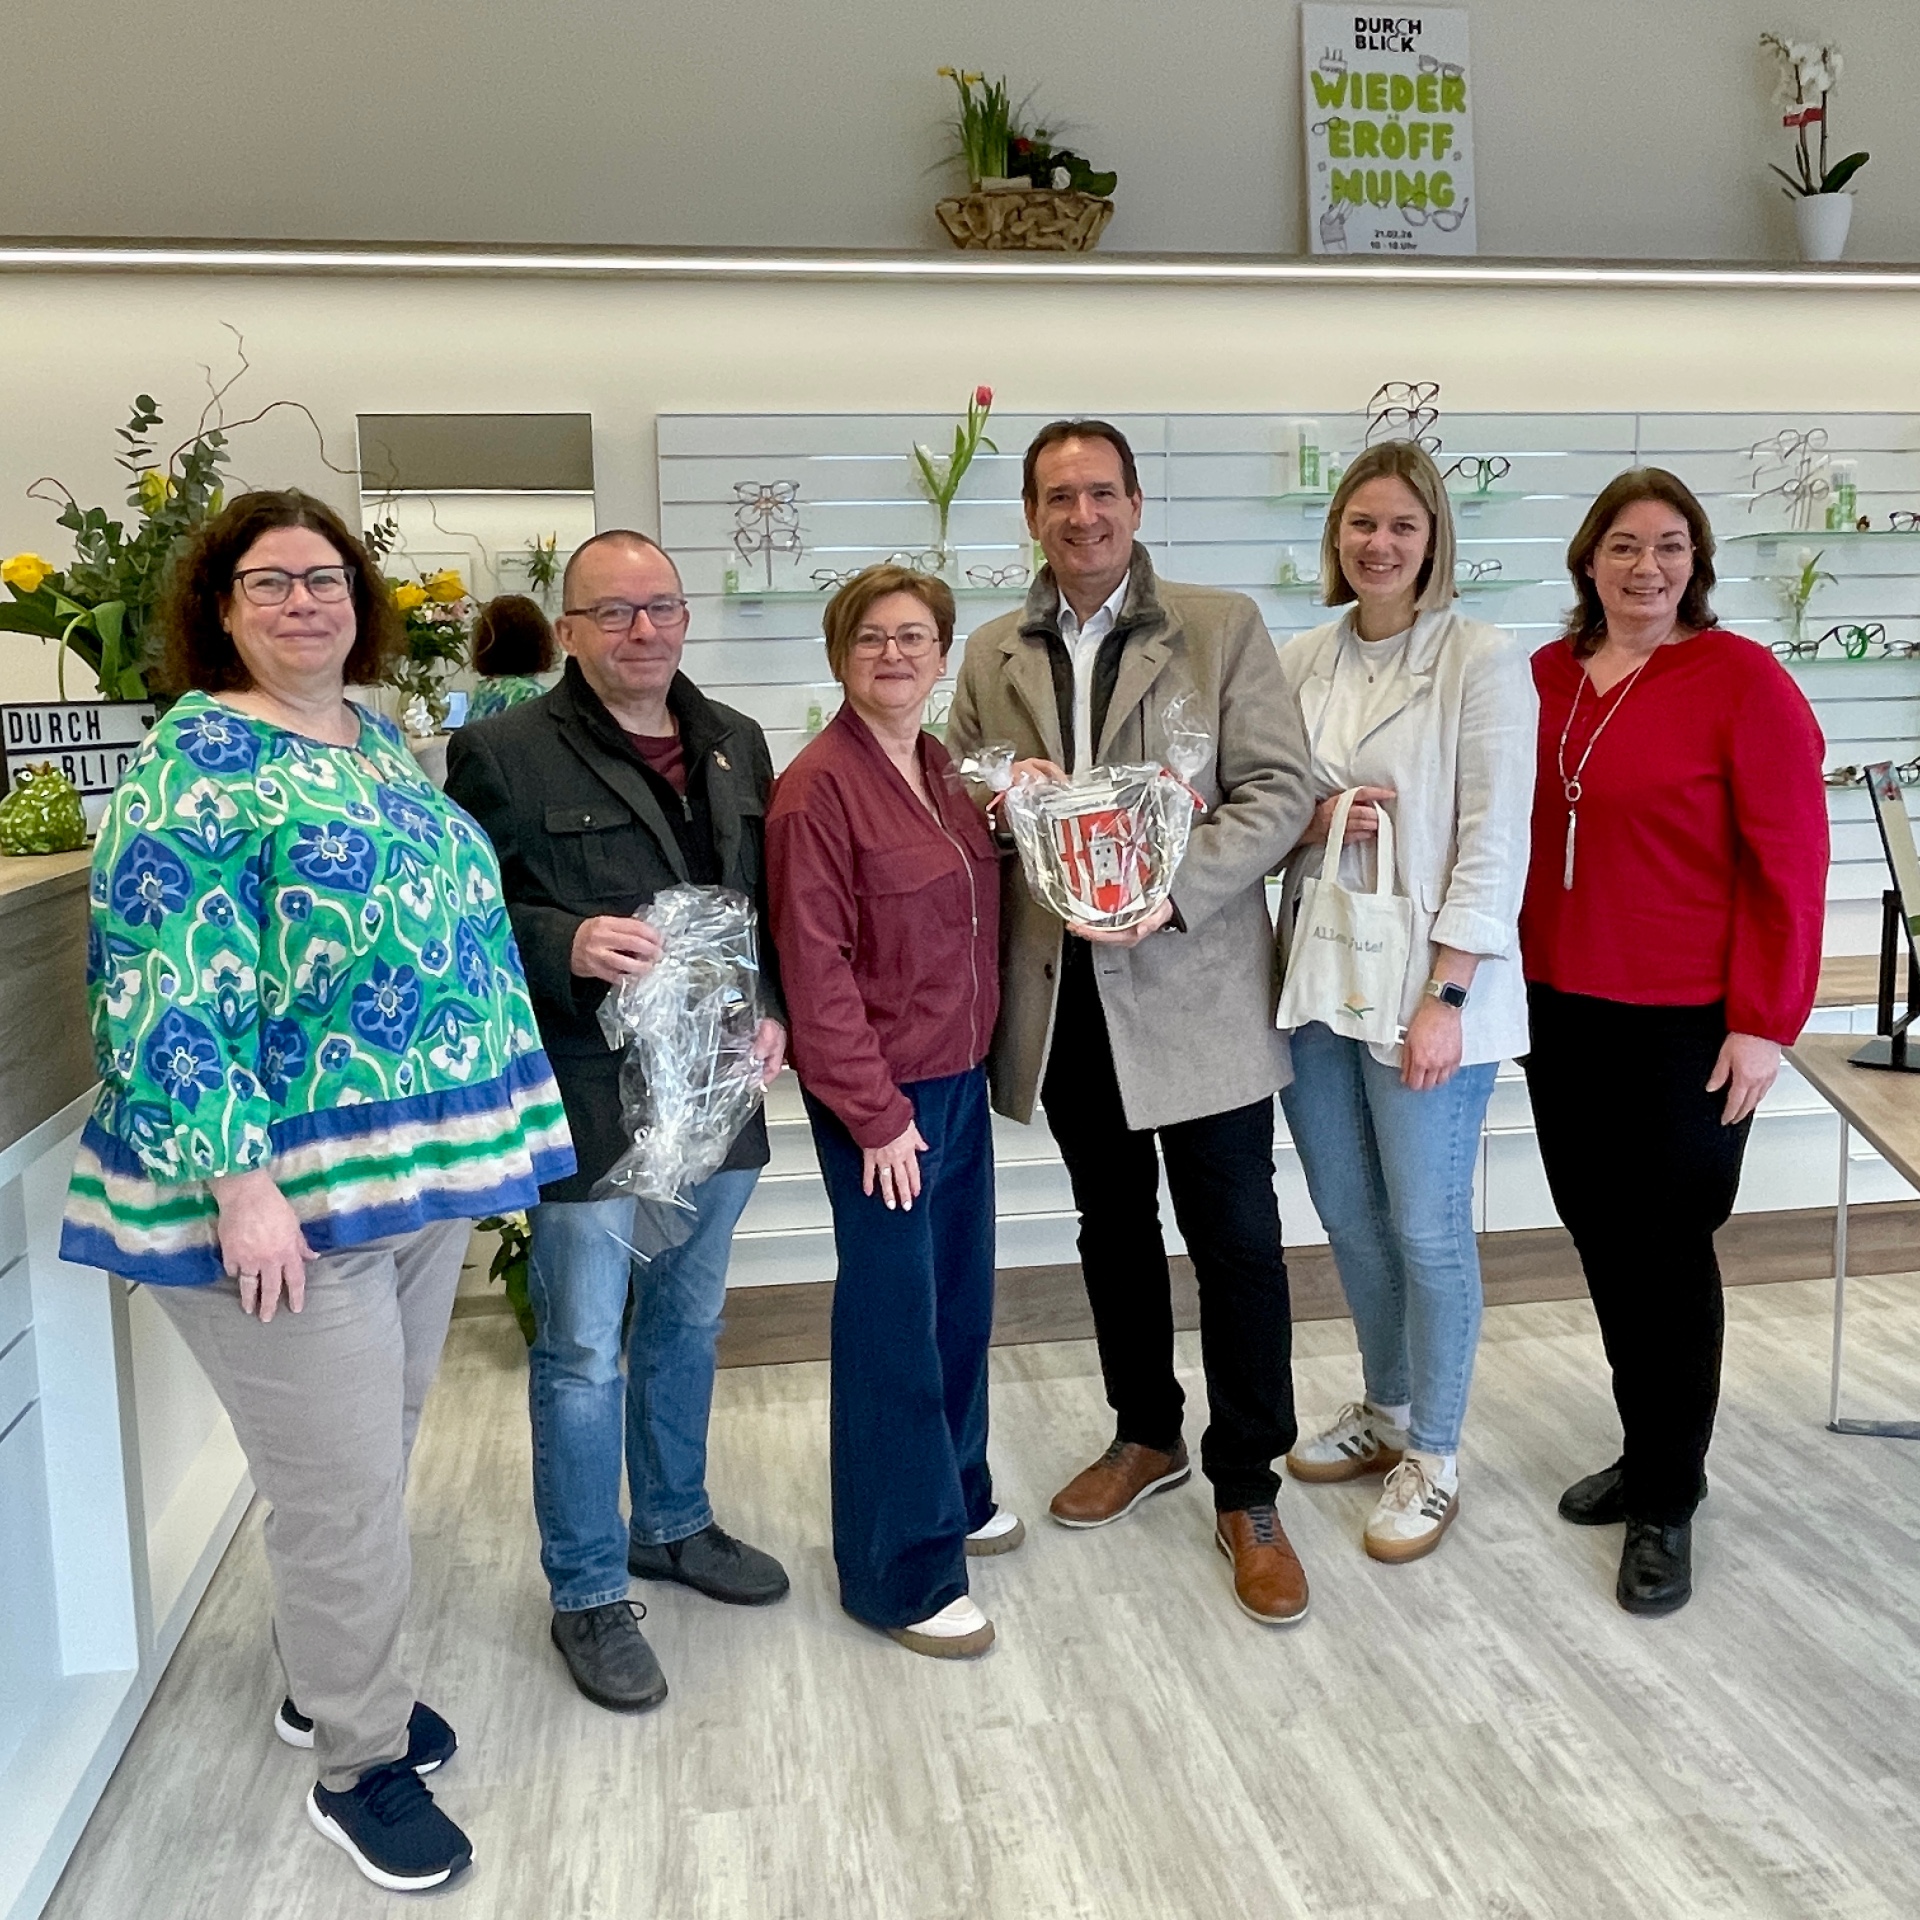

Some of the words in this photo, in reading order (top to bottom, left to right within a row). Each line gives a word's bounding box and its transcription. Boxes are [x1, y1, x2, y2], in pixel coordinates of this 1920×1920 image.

[1354, 17, 1422, 35] DURCH
[1355, 34, 1416, 53] BLICK
[1310, 71, 1466, 113] WIEDER
[1328, 114, 1454, 160] ERÖFF
[1331, 167, 1455, 209] NUNG
[8, 710, 101, 744] DURCH
